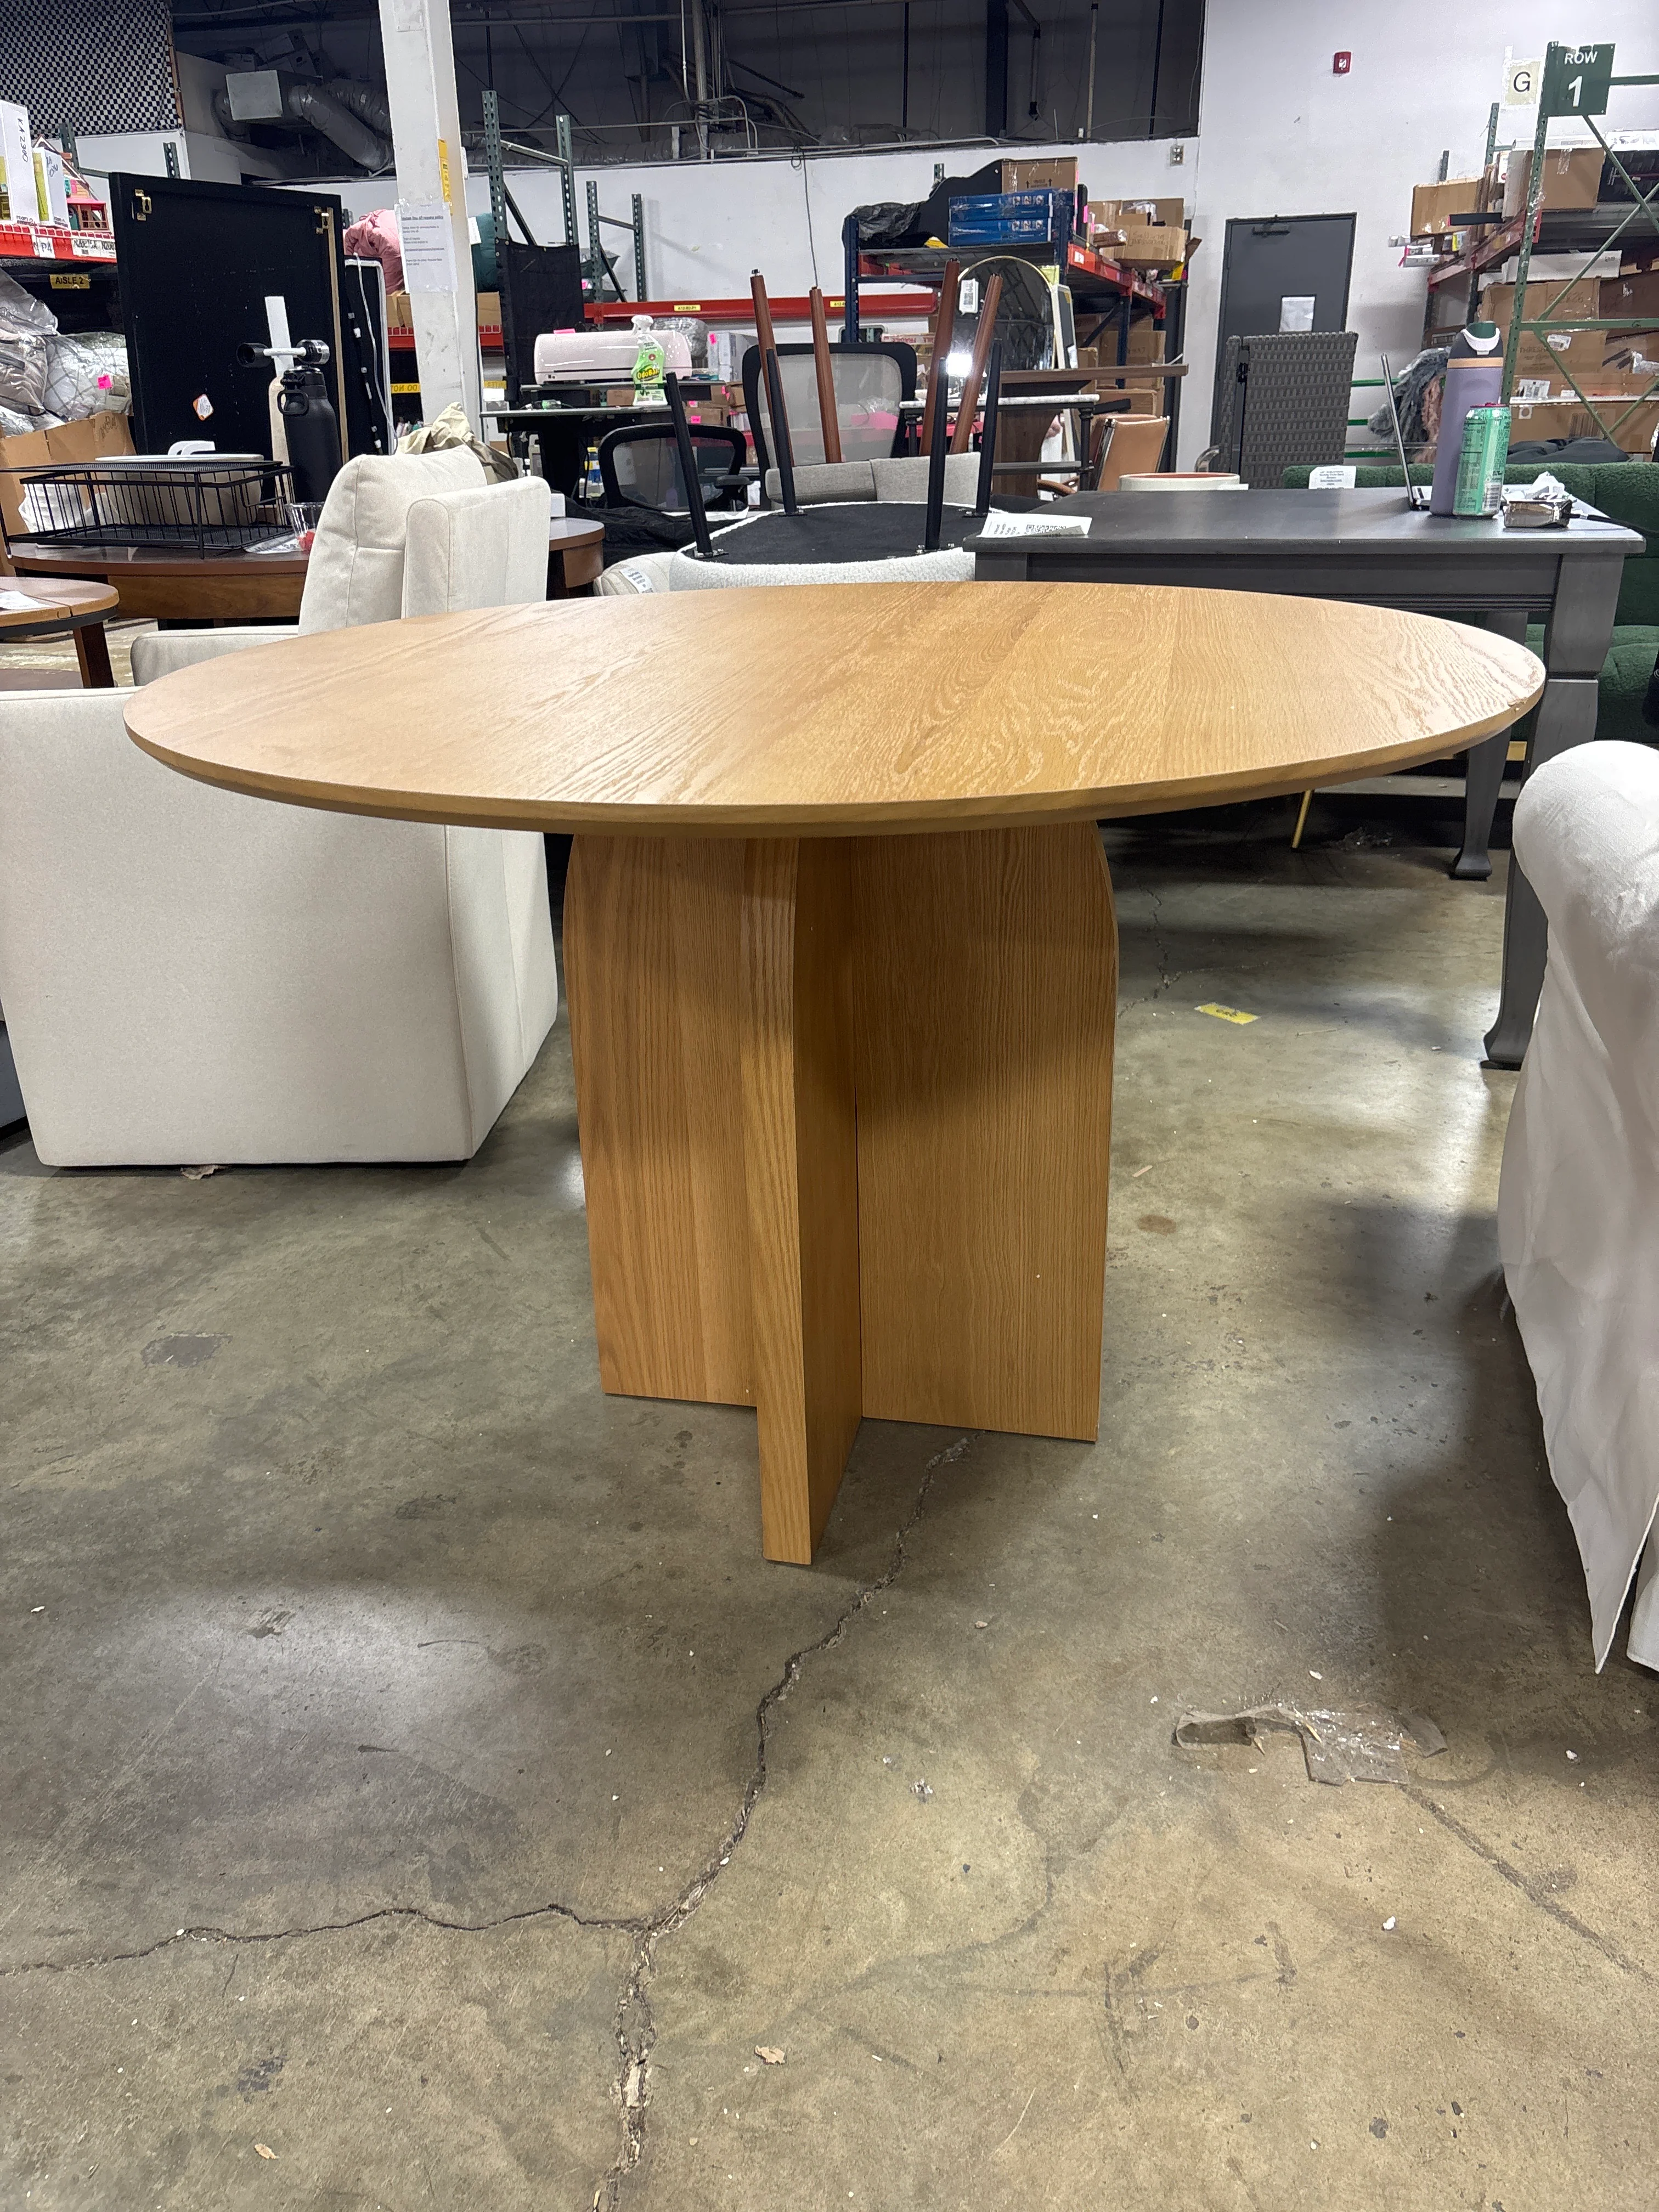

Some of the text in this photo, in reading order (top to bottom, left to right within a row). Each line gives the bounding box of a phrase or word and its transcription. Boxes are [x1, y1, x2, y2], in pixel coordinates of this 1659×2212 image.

[1564, 50, 1598, 65] ROW
[1513, 71, 1531, 93] G
[1567, 75, 1583, 108] 1
[41, 242, 52, 253] P4
[55, 276, 84, 285] AISLE 2
